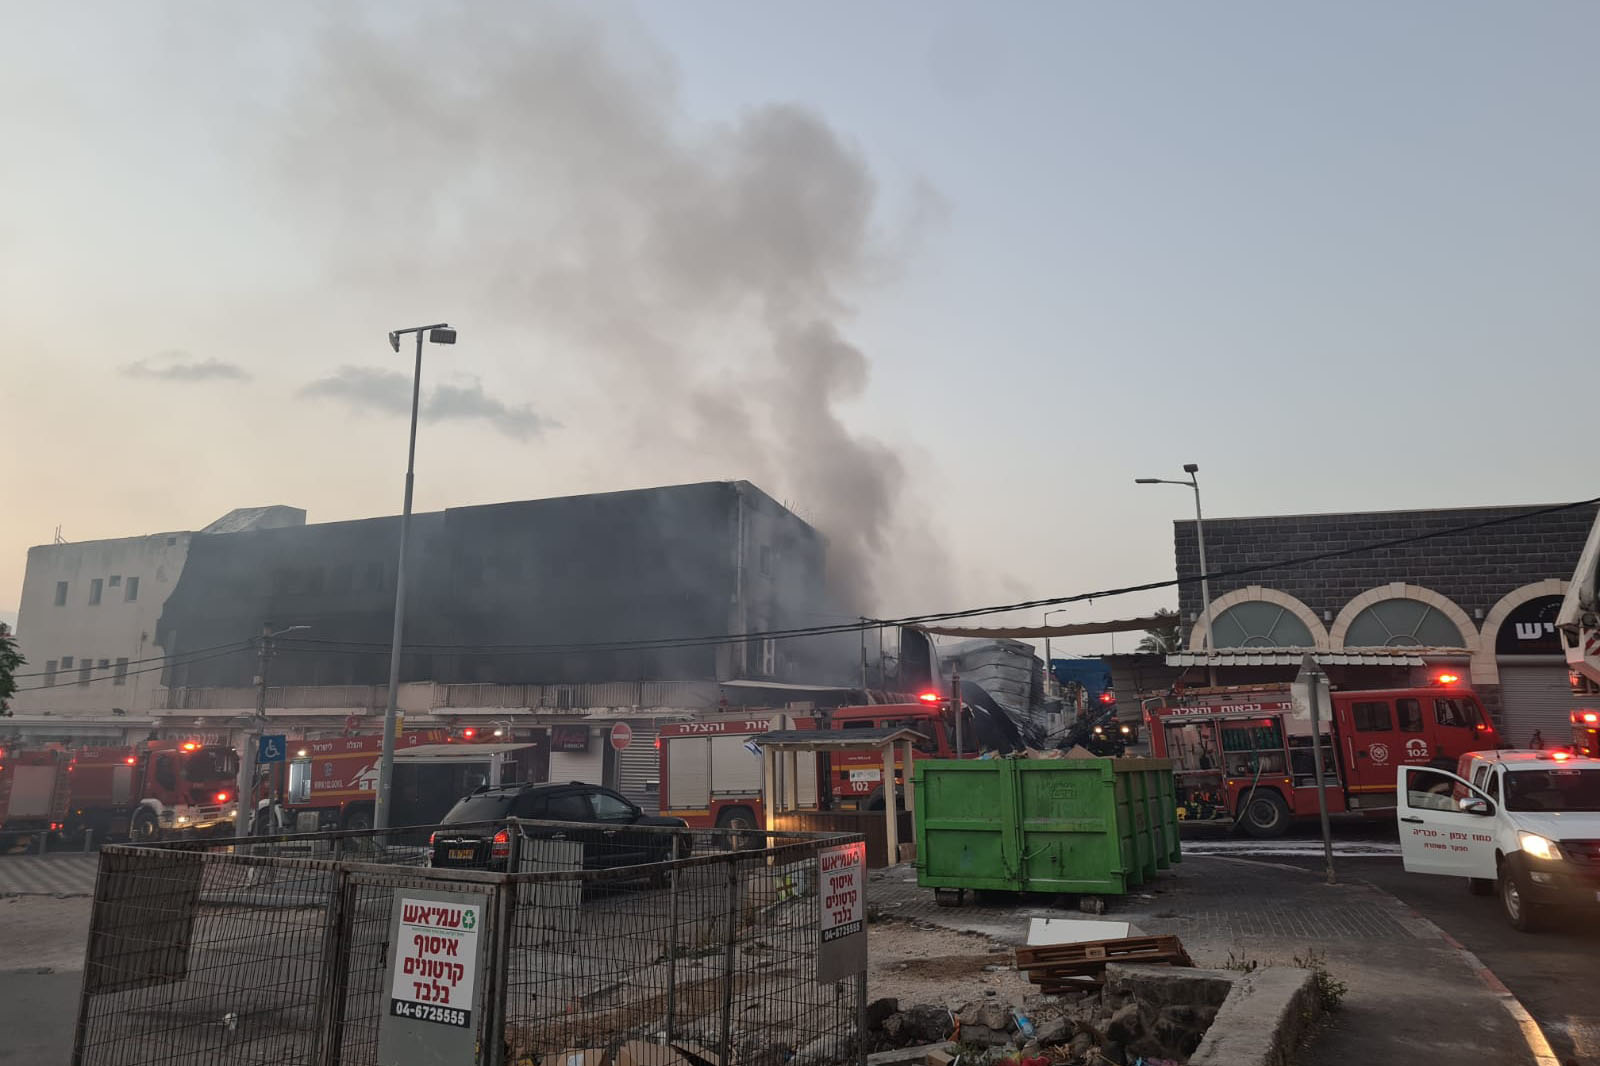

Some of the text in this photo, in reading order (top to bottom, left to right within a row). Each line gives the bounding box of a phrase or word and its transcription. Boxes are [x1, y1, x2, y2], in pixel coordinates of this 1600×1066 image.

[1171, 706, 1212, 716] והצלה
[680, 719, 770, 733] אות והצלה
[1407, 748, 1429, 757] 102
[851, 781, 869, 792] 102
[1412, 828, 1437, 837] טבריה
[1449, 831, 1468, 841] צפון
[829, 873, 854, 894] איסוף
[825, 889, 857, 909] קרטונים
[832, 906, 852, 925] בלבד
[413, 933, 459, 958] איסוף
[403, 956, 465, 987] קרטונים
[413, 978, 450, 1005] בלבד
[395, 1001, 465, 1026] 04-6725555
